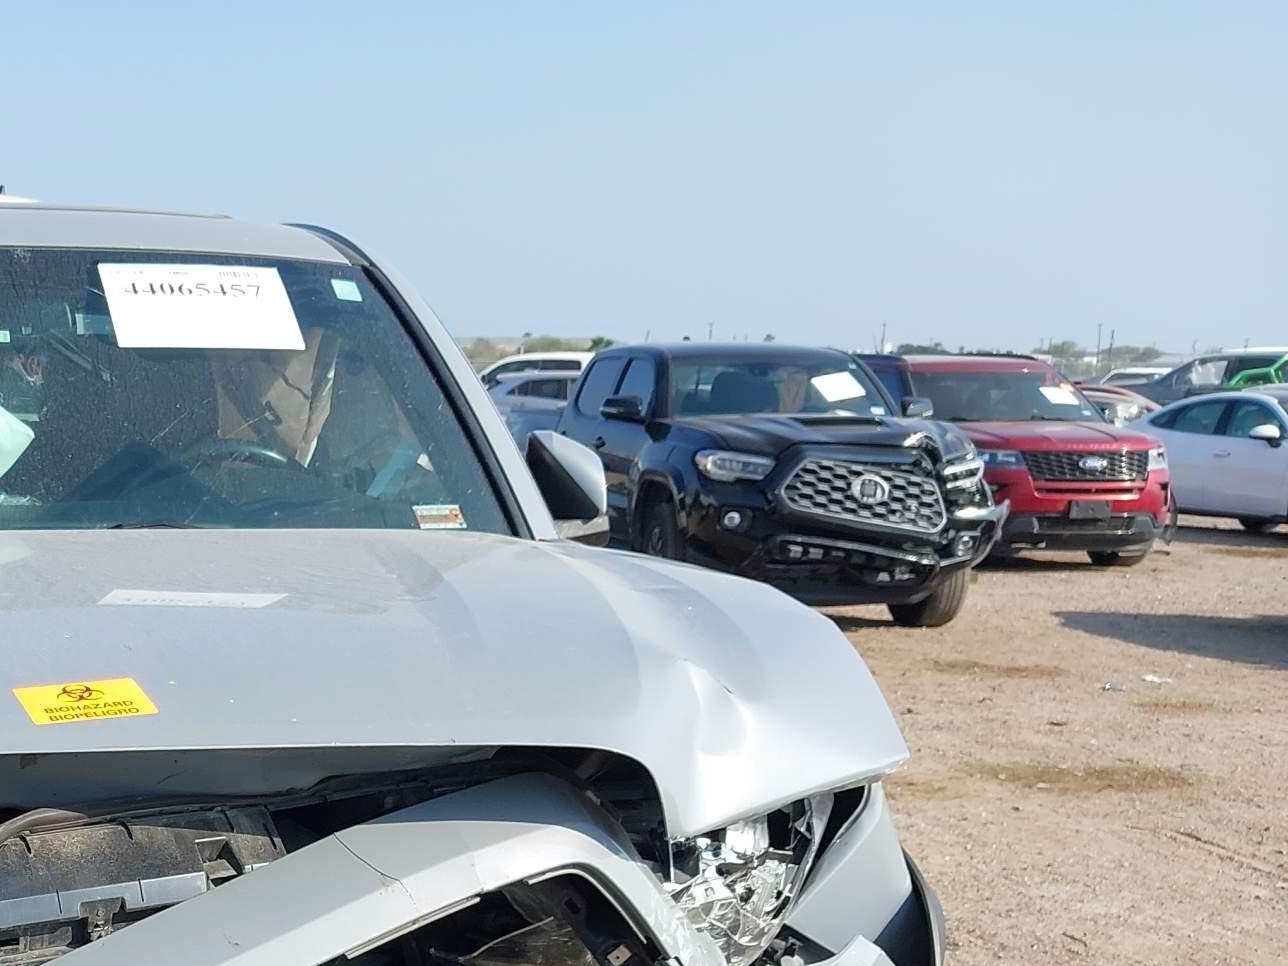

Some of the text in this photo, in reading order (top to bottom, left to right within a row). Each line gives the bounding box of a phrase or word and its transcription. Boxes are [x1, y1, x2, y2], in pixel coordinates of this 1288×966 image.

[124, 282, 261, 298] 44065457
[43, 700, 134, 714] BIOHAZARD
[48, 707, 140, 721] BIOPELIGRO
